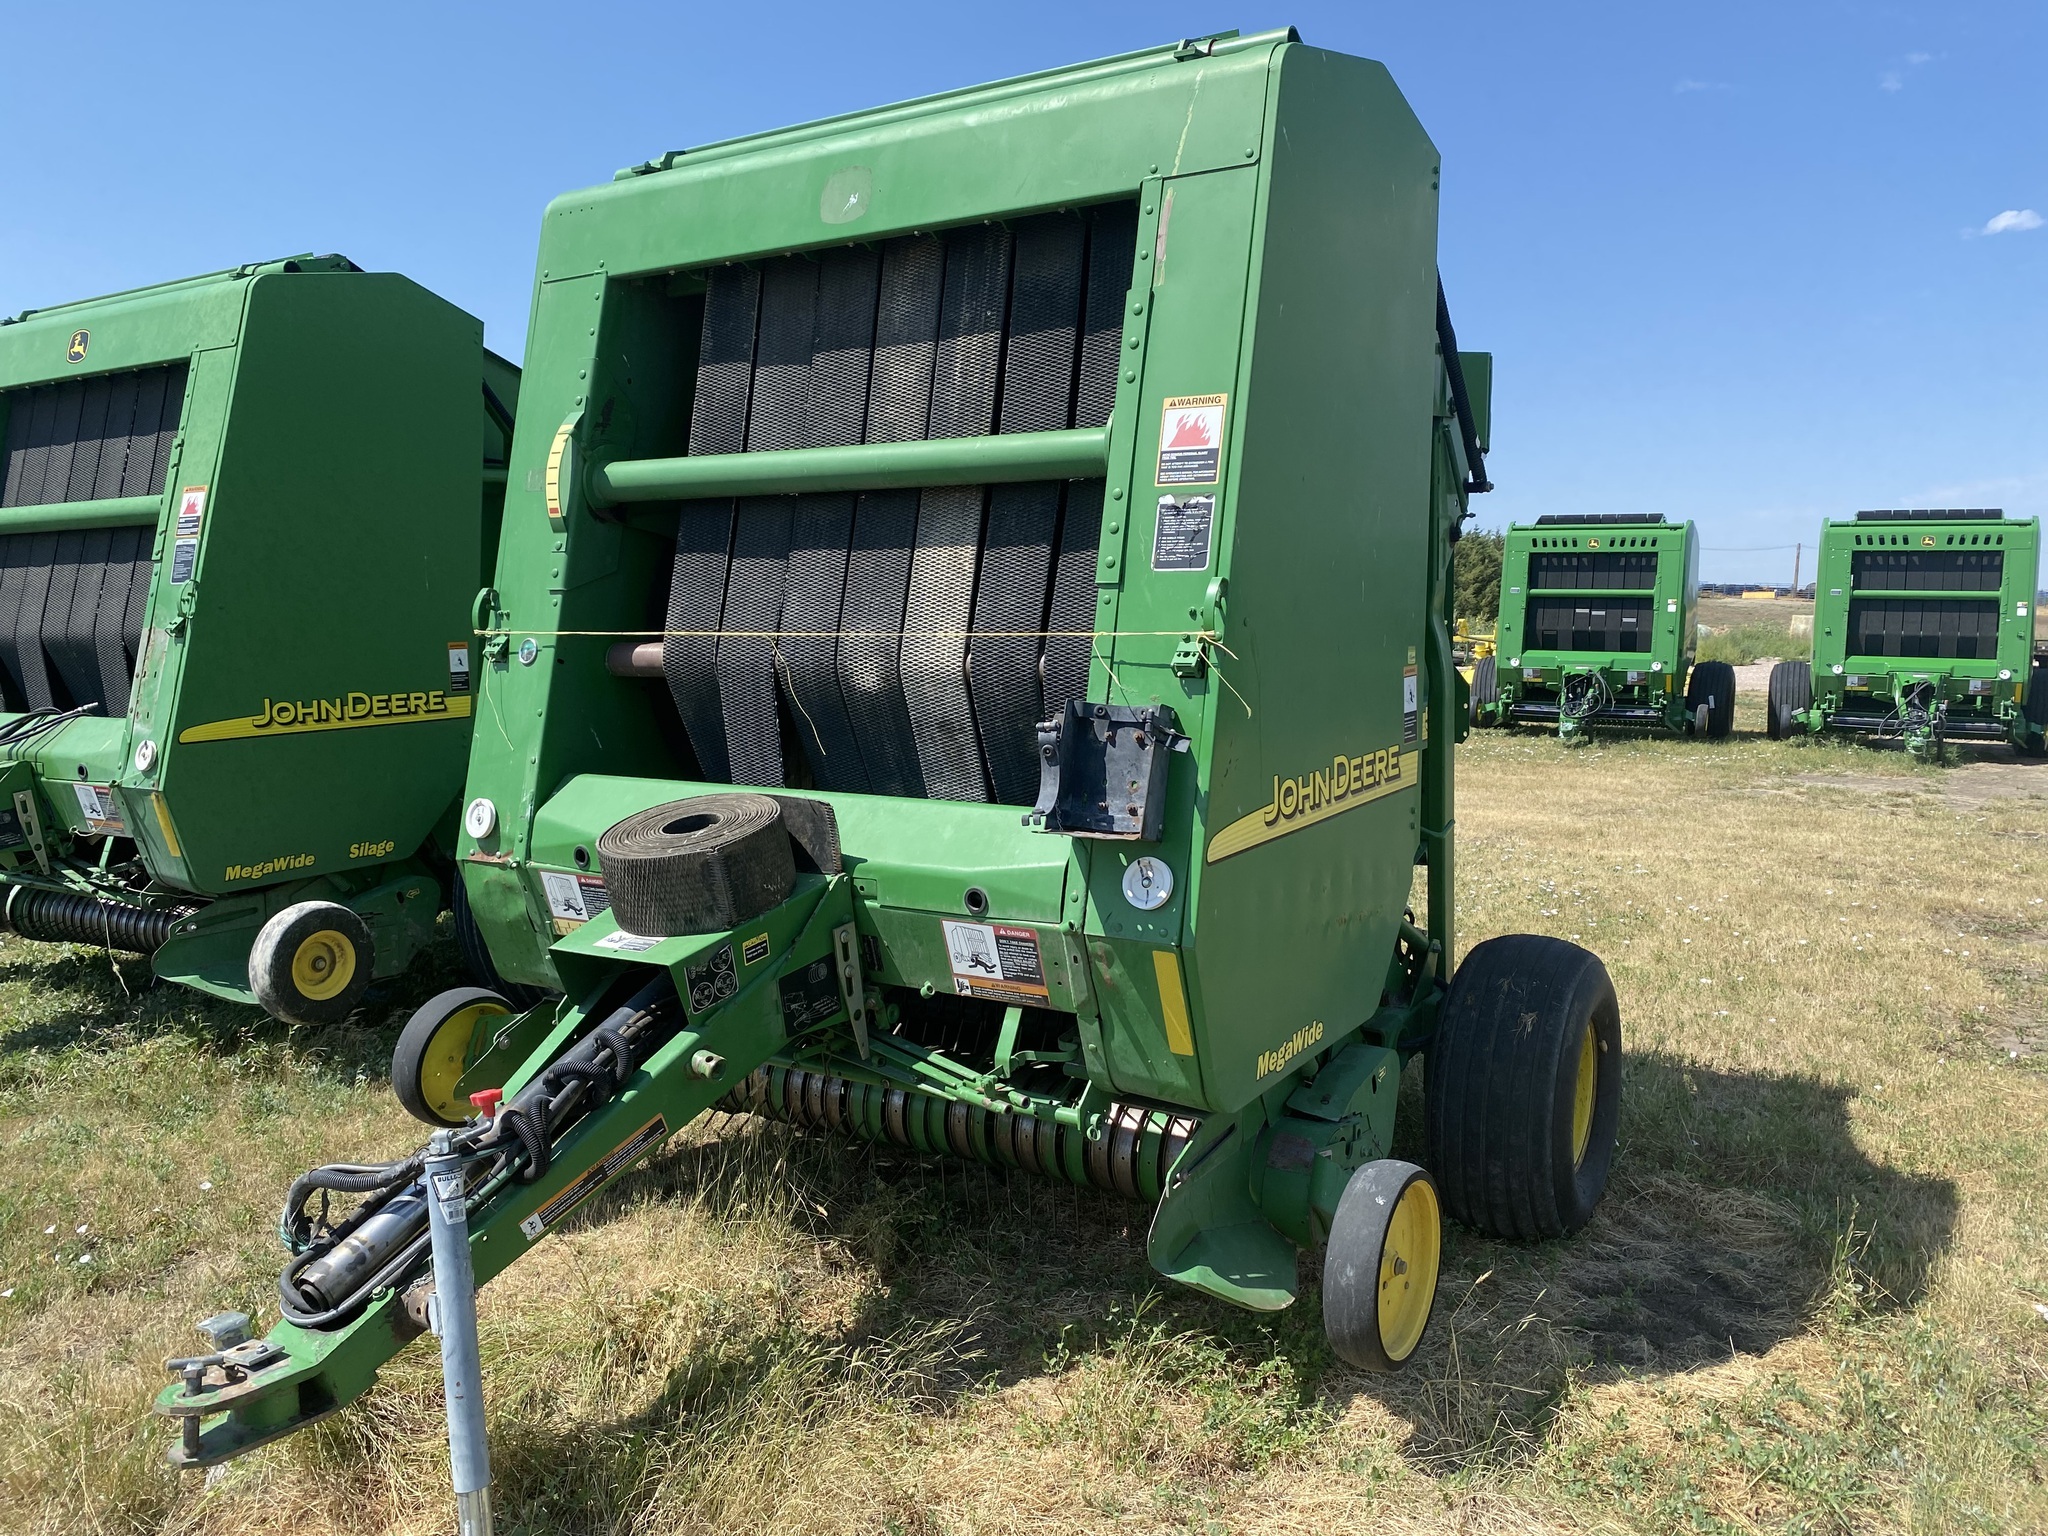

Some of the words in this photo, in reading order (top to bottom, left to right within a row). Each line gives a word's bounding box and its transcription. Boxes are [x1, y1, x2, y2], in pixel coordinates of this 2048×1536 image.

[1177, 395, 1222, 407] WARNING
[252, 698, 343, 727] JOHN
[347, 690, 447, 719] DEERE
[1263, 767, 1331, 827] JOHN
[1333, 744, 1401, 803] DEERE
[349, 839, 395, 859] Silage
[225, 853, 315, 882] MegaWide
[1006, 929, 1031, 938] DANGER
[996, 983, 1022, 991] WARNING
[1256, 1020, 1324, 1081] MegaWide
[591, 1151, 615, 1171] WARNING
[437, 1174, 462, 1183] BULLDO
